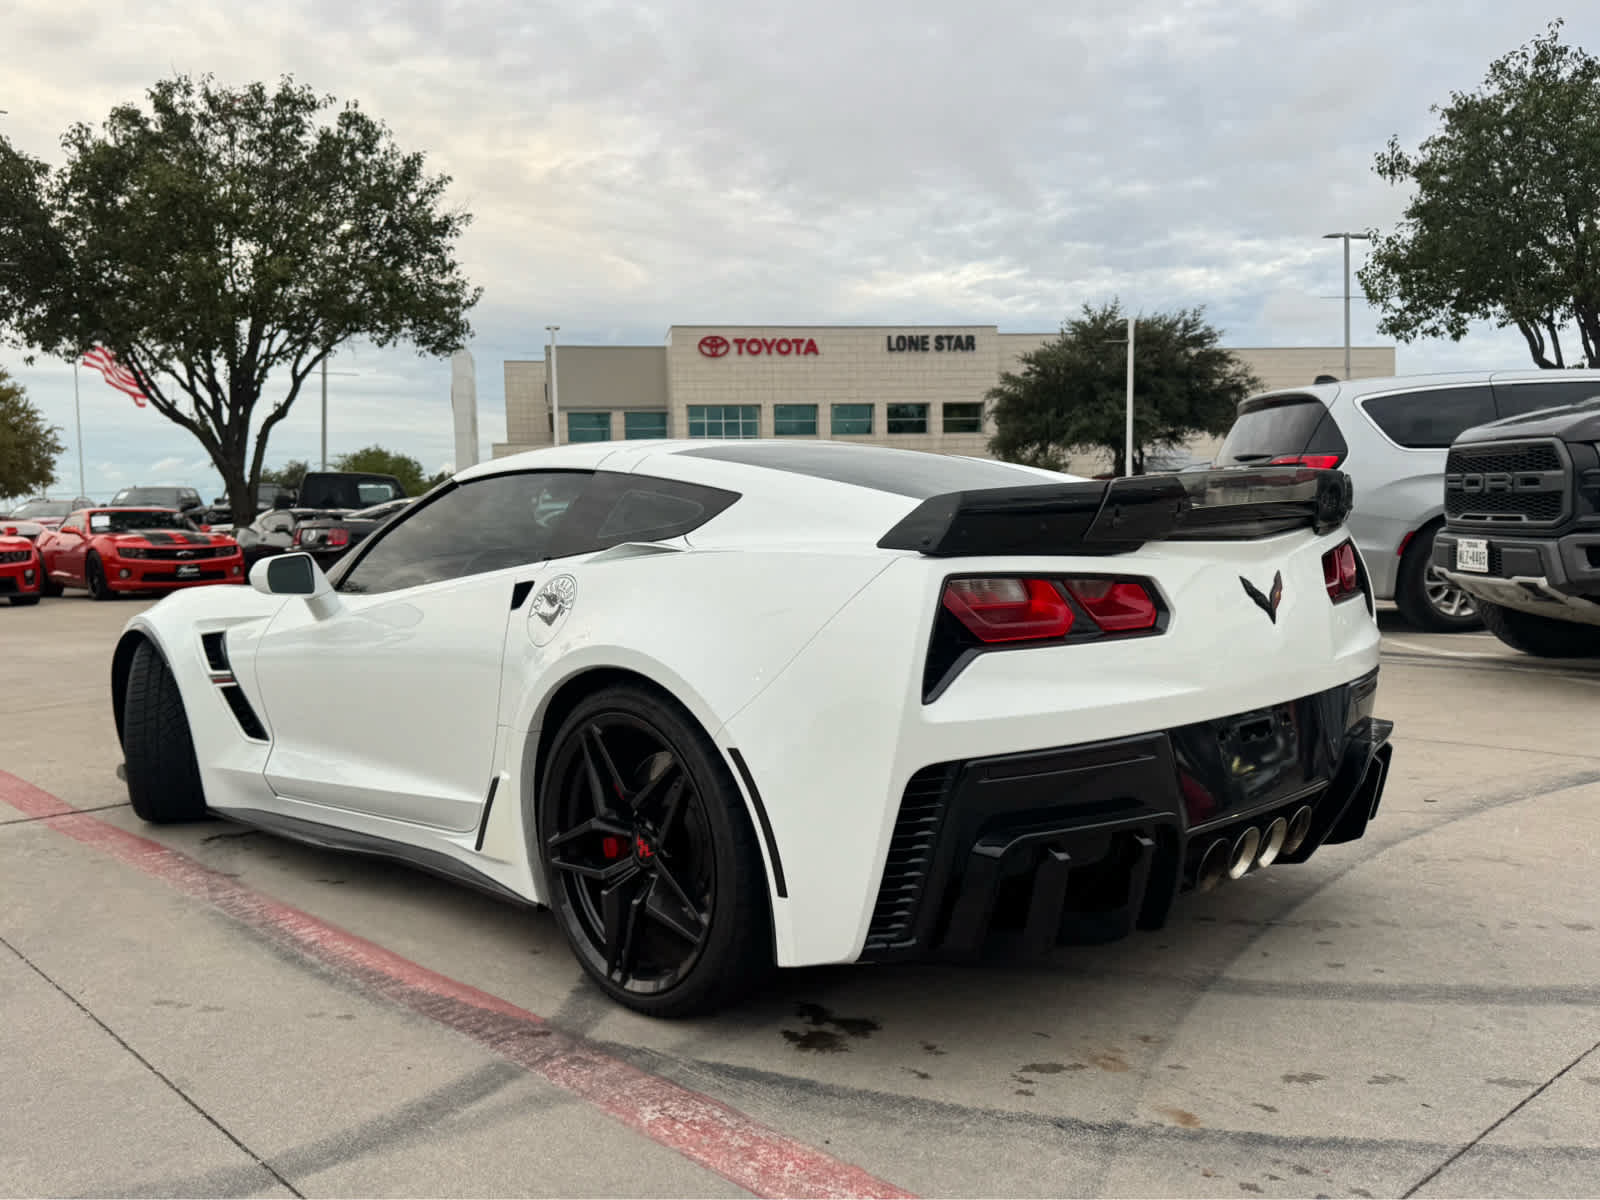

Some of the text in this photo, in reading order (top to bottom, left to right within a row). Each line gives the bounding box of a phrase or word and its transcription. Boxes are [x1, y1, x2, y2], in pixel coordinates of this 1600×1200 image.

[732, 338, 819, 356] TOYOTA
[887, 335, 976, 352] LONE STAR
[1447, 471, 1544, 494] FORD
